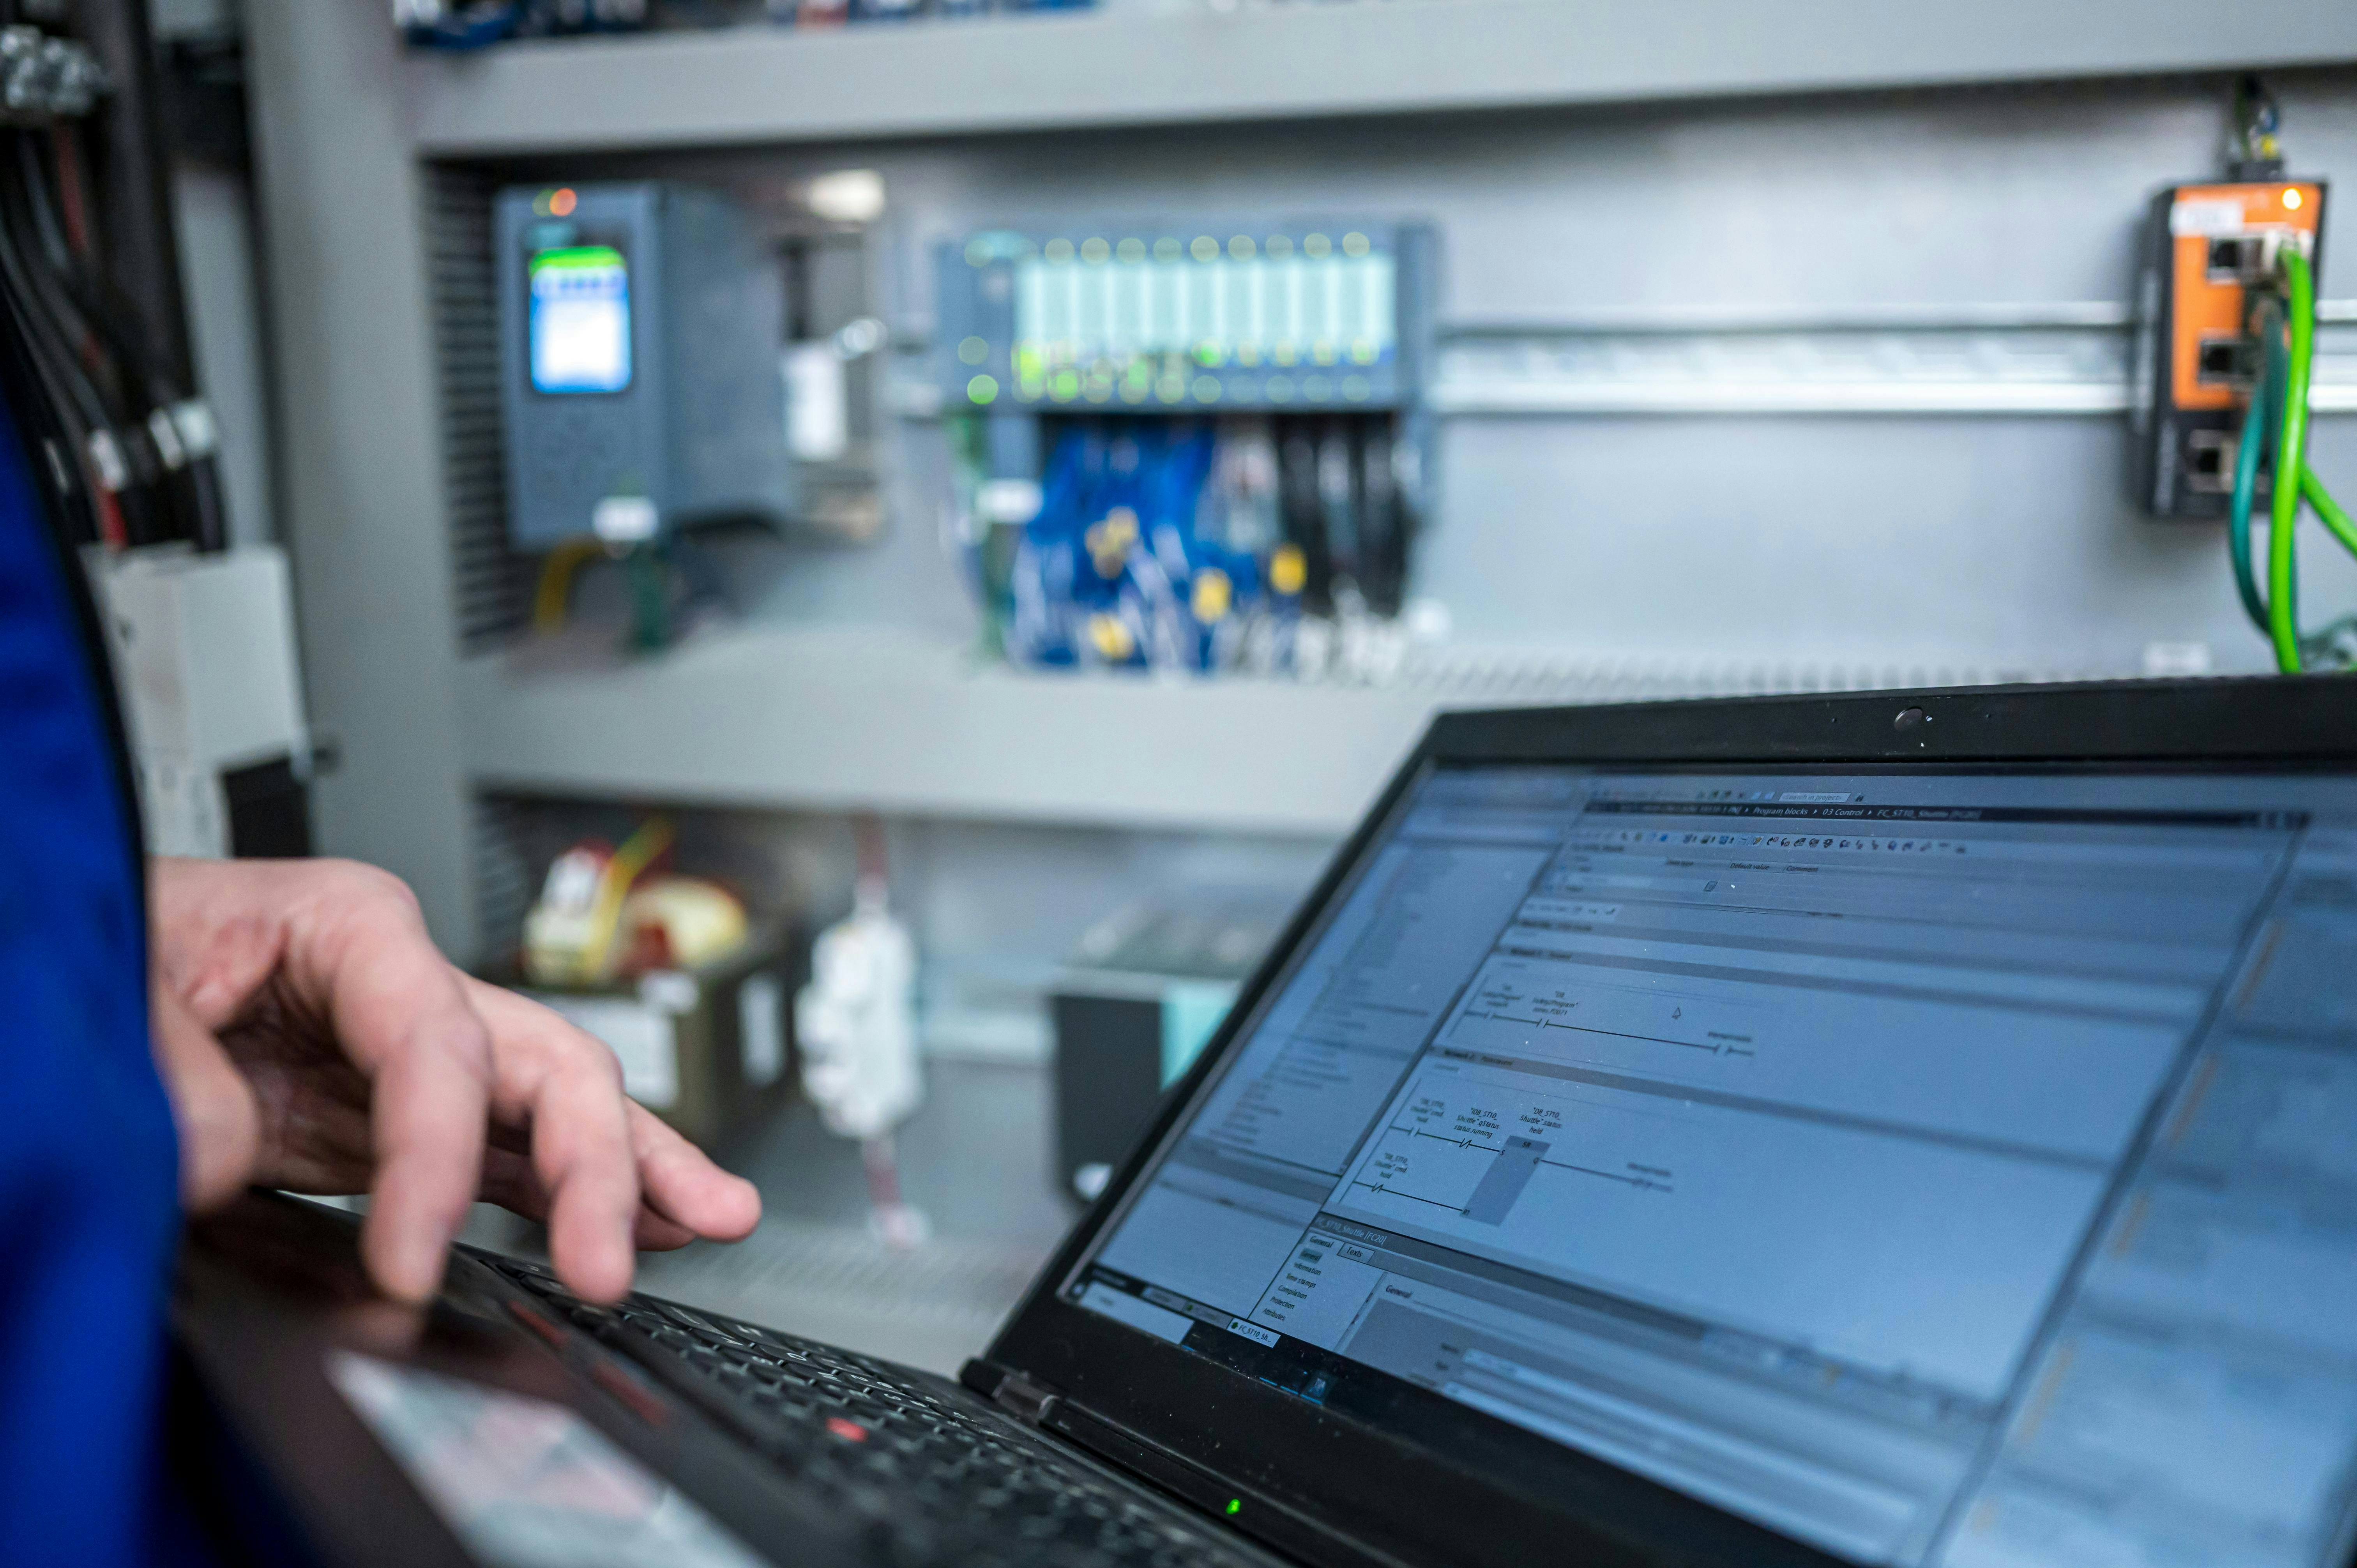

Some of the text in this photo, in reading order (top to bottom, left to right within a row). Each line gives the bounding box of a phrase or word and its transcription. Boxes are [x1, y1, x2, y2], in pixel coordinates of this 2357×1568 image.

[1753, 806, 1783, 816] Program
[1453, 1125, 1493, 1139] status.running
[1309, 1236, 1335, 1248] General
[1364, 1231, 1387, 1245] [FC20]
[1346, 1247, 1363, 1257] Texts
[1294, 1262, 1322, 1275] Information
[1286, 1273, 1316, 1289] Time stamps
[1278, 1285, 1307, 1300] Compilation
[1270, 1296, 1295, 1310] Protection
[1263, 1308, 1286, 1321] Attributes
[1238, 1324, 1272, 1342] FC_ST10_Sh...
